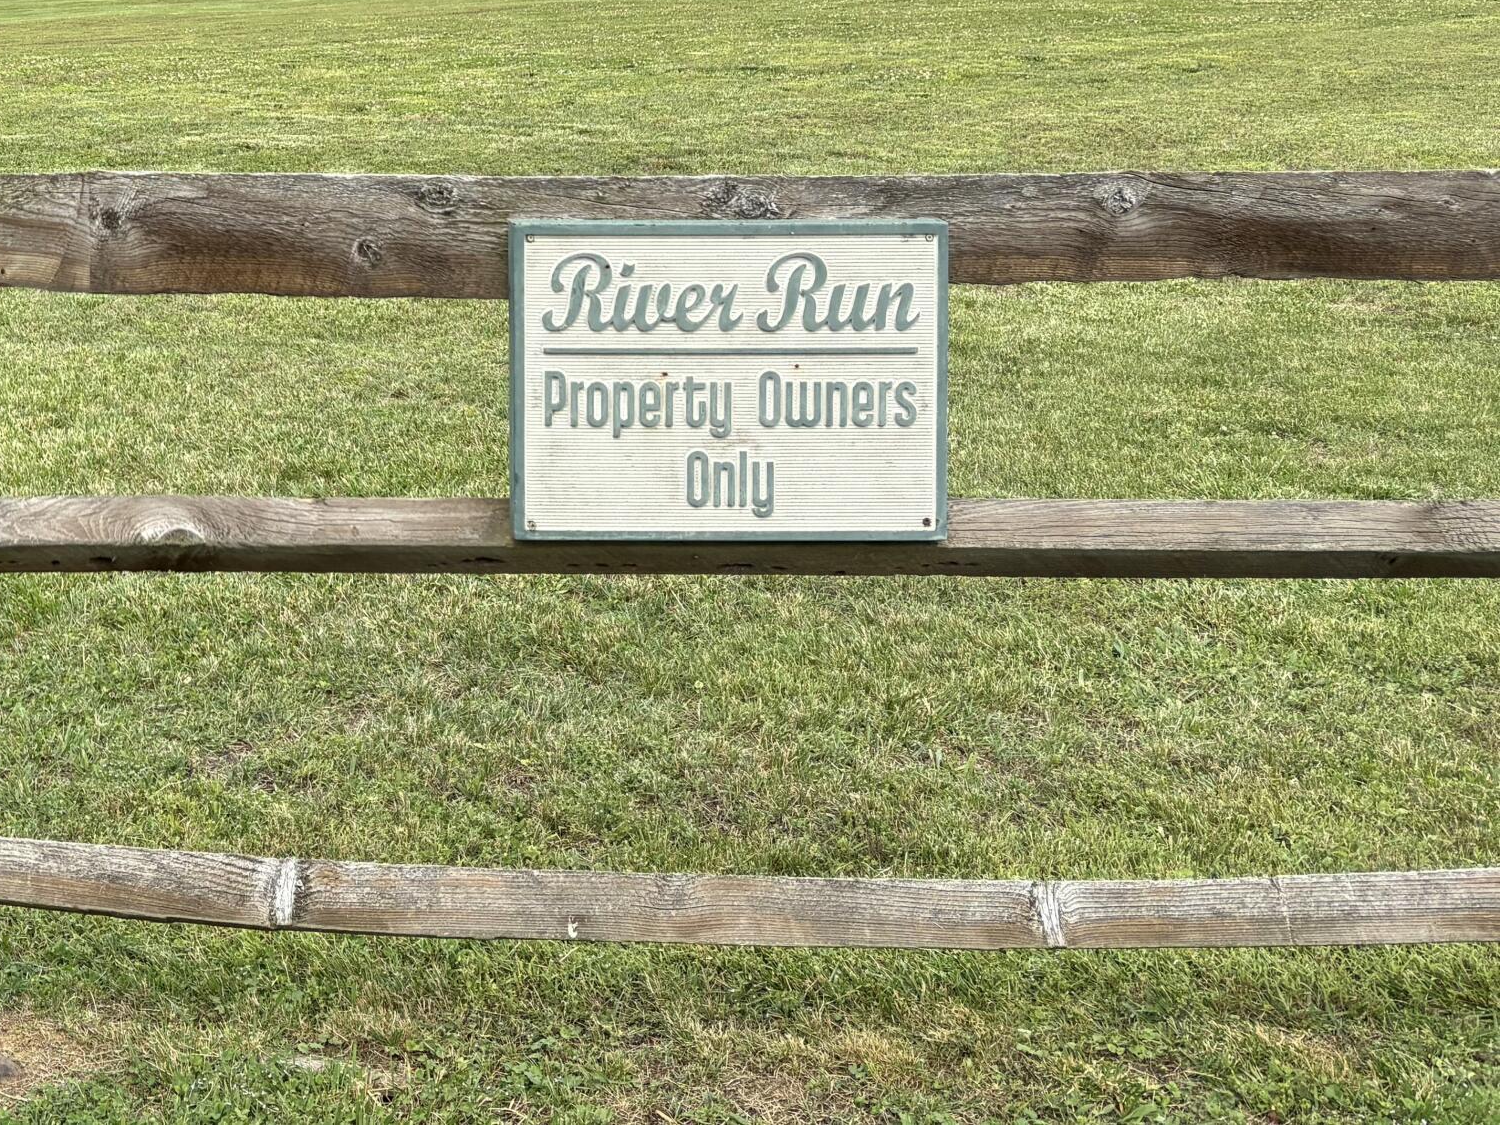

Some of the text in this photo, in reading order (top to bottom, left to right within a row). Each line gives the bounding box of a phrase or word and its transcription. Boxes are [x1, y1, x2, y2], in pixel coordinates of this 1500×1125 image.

[541, 252, 921, 332] River Run
[544, 371, 918, 439] Property Owners
[686, 451, 775, 518] Only
